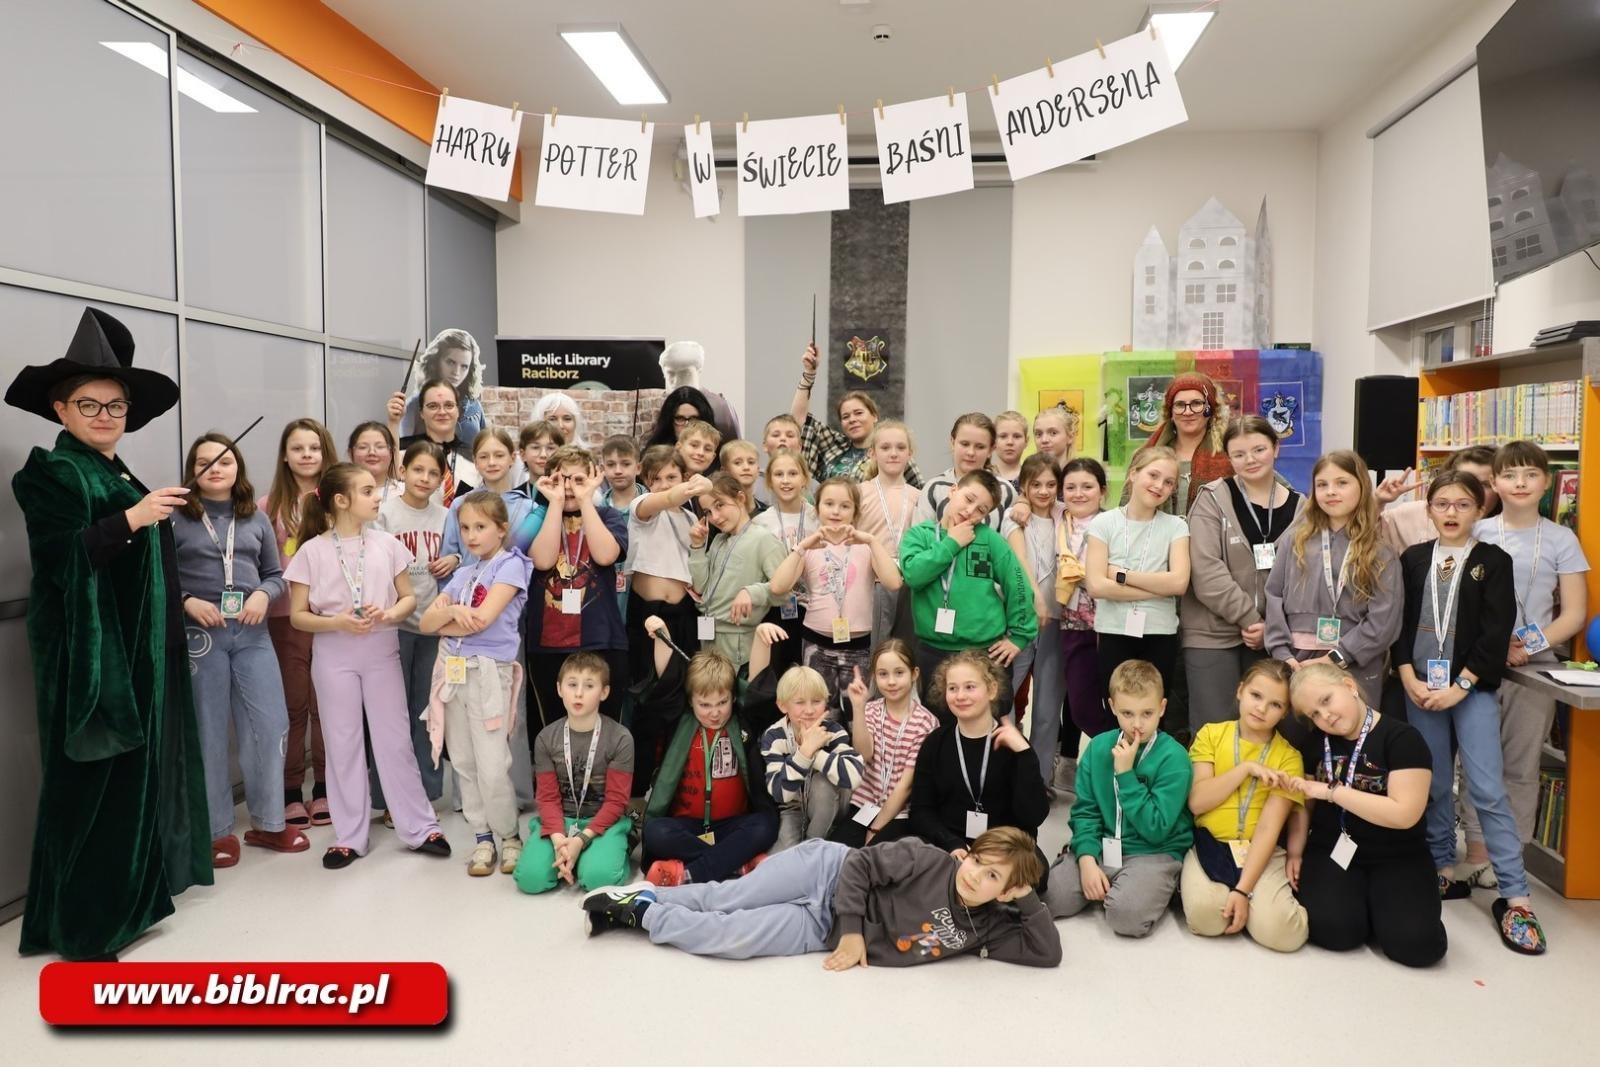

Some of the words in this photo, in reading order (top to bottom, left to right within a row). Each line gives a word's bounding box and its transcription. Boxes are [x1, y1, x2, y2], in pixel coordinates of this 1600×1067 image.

[435, 123, 511, 168] HARRY
[544, 142, 638, 182] POTTER
[693, 151, 712, 185] W
[742, 142, 842, 190] ŚWIECIE
[885, 122, 965, 175] BAŚNI
[1005, 61, 1161, 146] ANDERSENA
[521, 353, 561, 365] Public
[564, 353, 610, 368] Library
[522, 368, 579, 380] Raciborz
